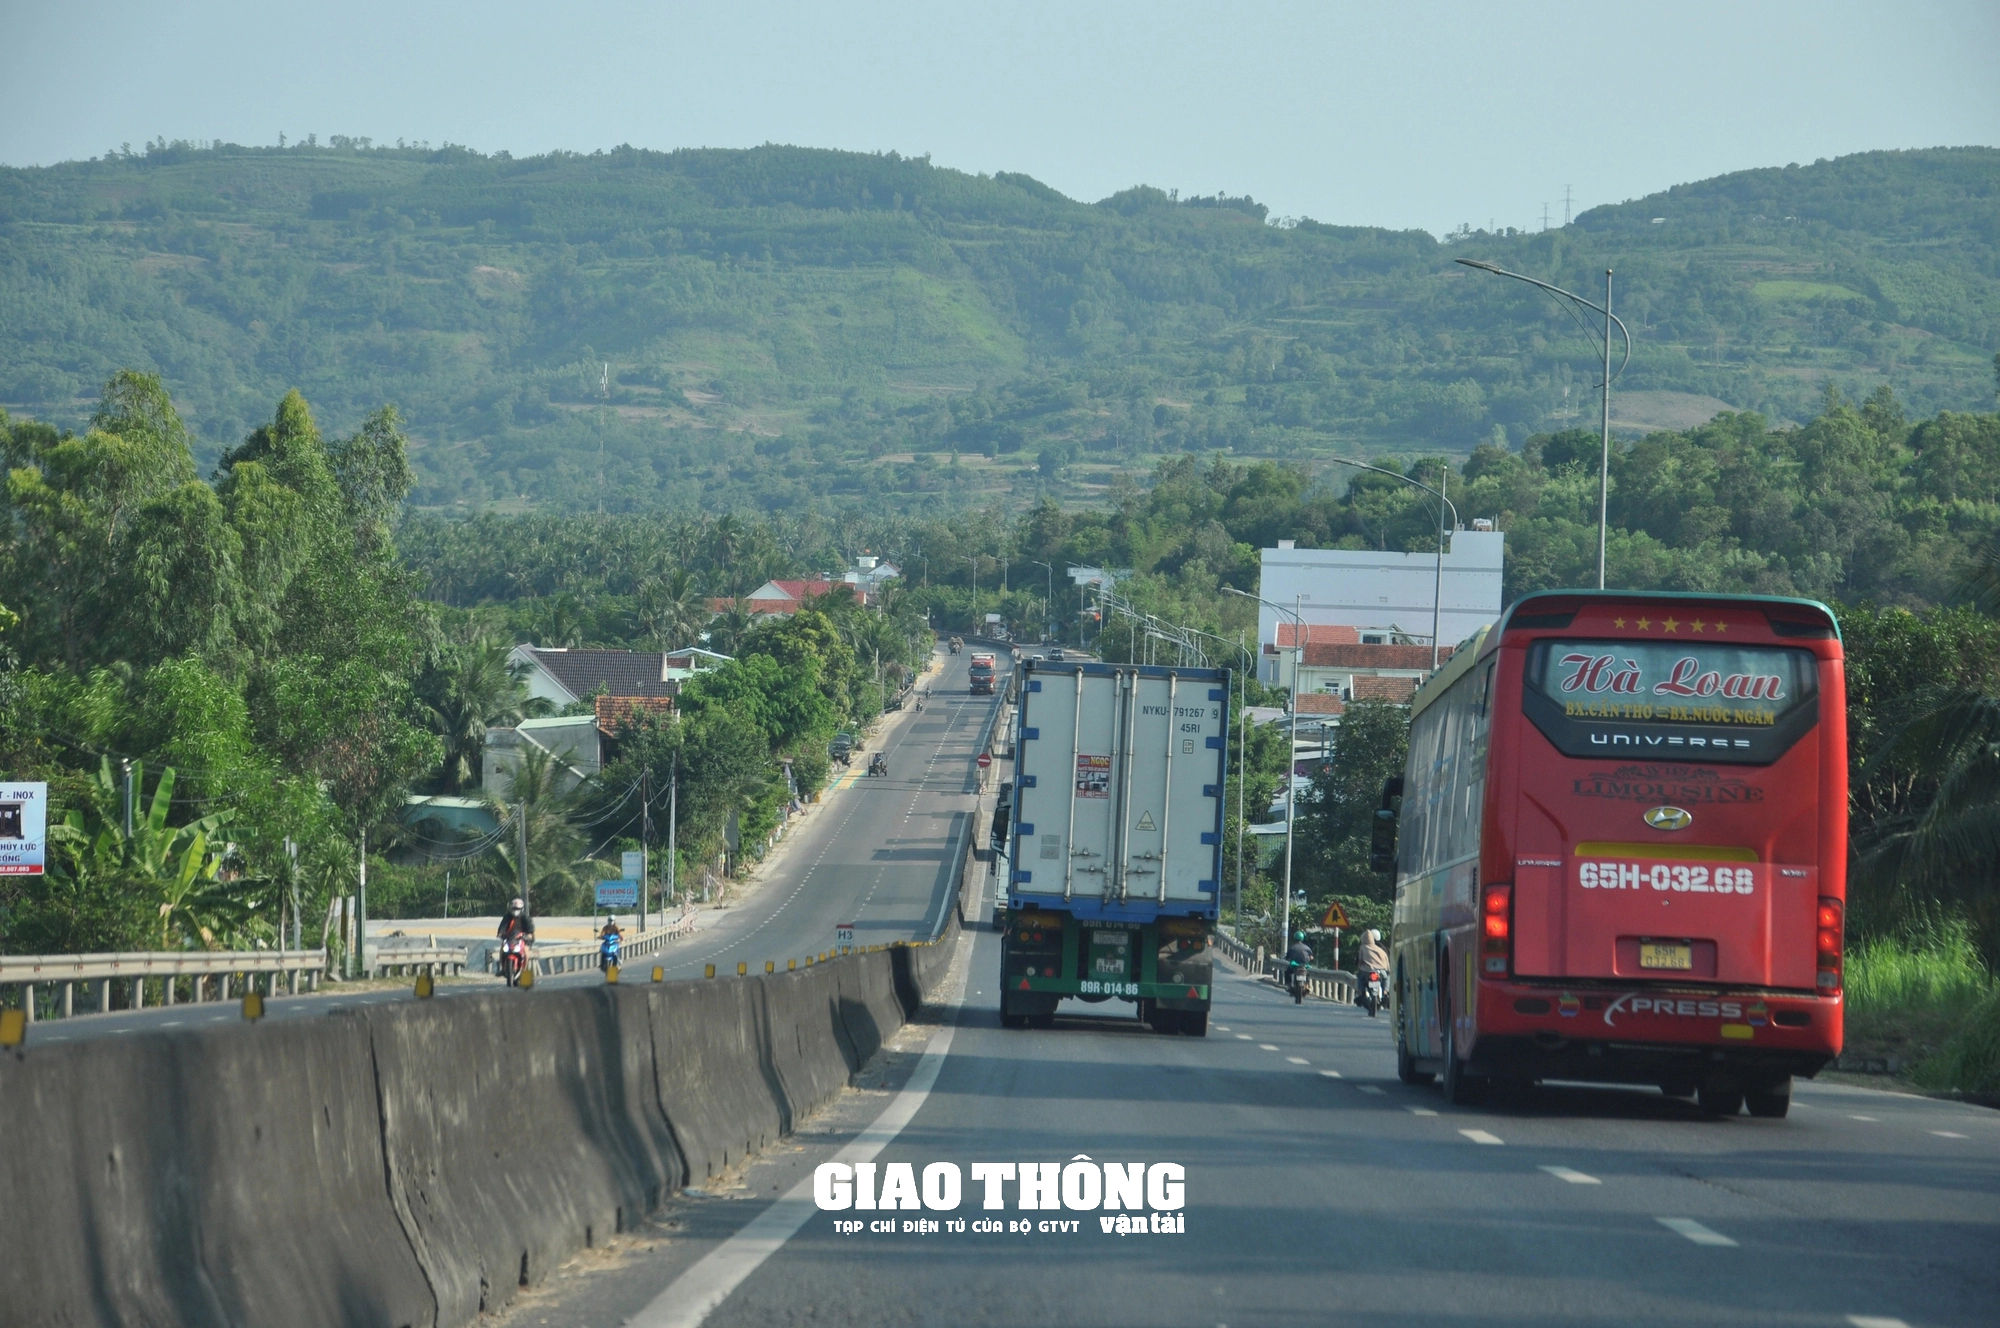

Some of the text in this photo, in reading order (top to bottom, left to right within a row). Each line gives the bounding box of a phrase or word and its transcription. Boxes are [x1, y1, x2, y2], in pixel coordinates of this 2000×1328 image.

[1558, 653, 1786, 700] Hà Loan
[1174, 707, 1205, 718] 791267
[1590, 733, 1750, 748] UNIVERSE
[13, 791, 34, 799] INOX
[1572, 779, 1765, 802] LIMOUSINE
[1579, 862, 1754, 895] 65H-032.68
[838, 930, 853, 940] H3
